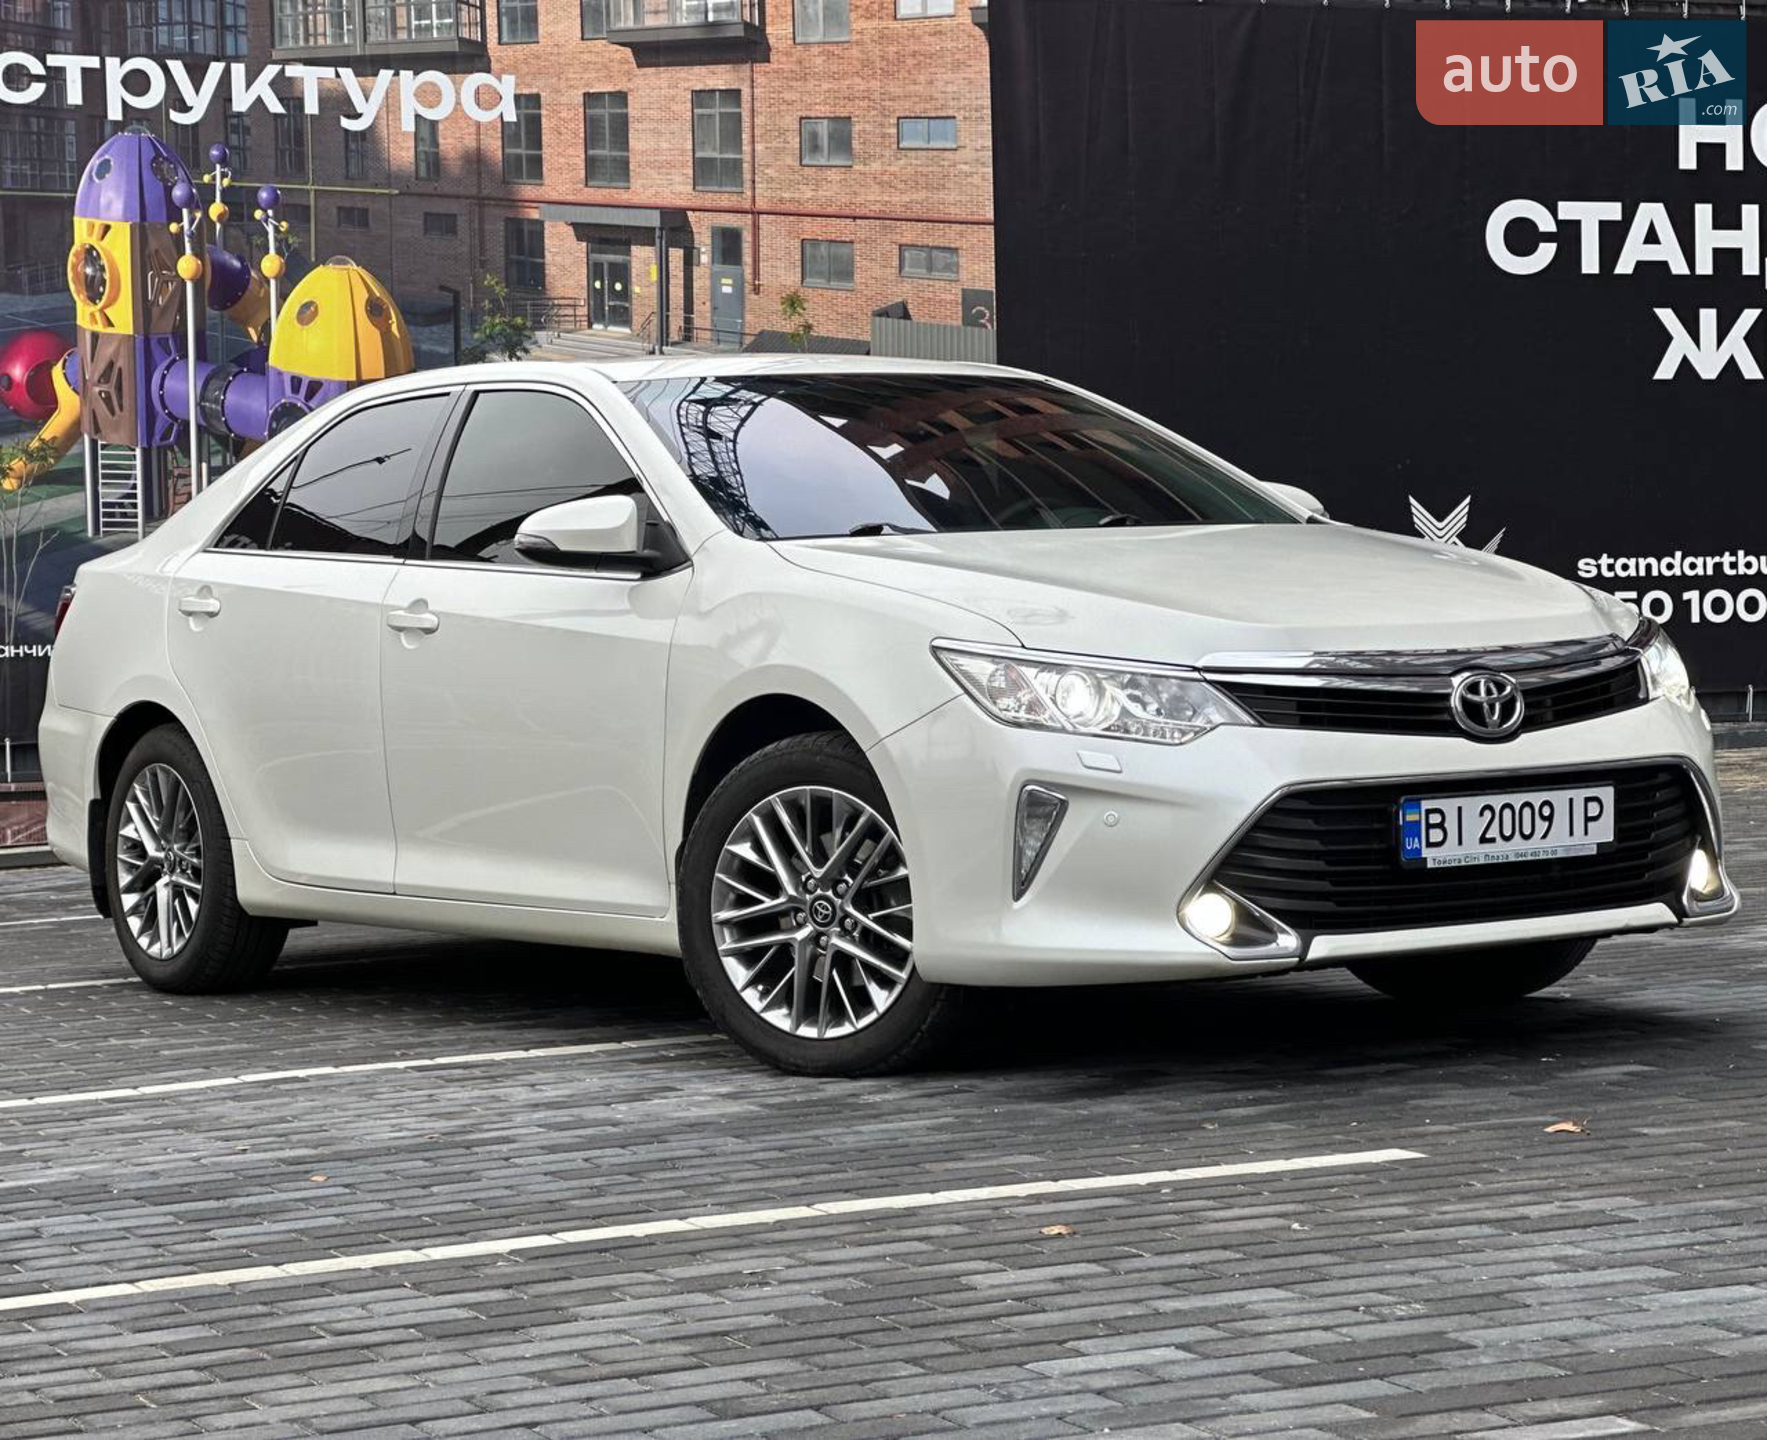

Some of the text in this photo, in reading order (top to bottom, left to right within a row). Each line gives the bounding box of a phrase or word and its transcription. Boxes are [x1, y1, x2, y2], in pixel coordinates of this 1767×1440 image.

[0, 51, 518, 132] структура
[1678, 97, 1767, 171] Н
[1405, 837, 1420, 850] UA
[1478, 799, 1555, 844] 2009
